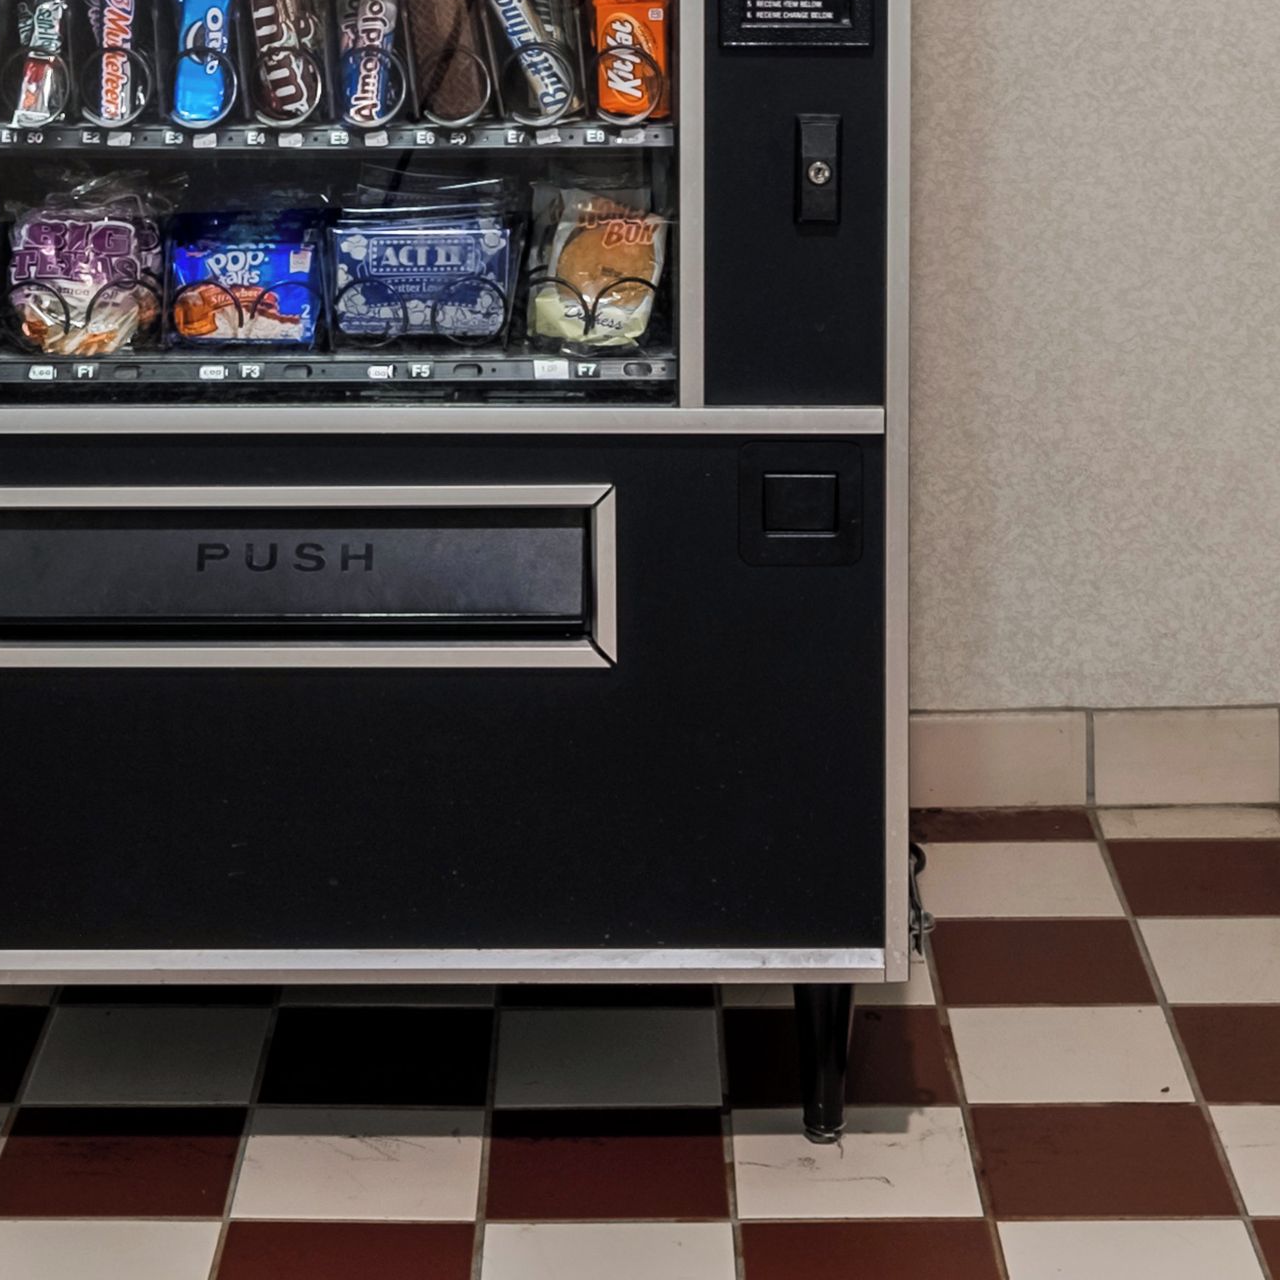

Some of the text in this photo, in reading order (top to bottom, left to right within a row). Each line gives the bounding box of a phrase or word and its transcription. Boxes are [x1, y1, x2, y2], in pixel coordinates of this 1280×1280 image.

[82, 132, 100, 143] E2
[165, 132, 184, 144] E3
[247, 132, 265, 144] E4
[330, 132, 349, 144] E5
[417, 132, 434, 144] E6
[586, 131, 604, 143] E8
[23, 222, 133, 256] BIG
[603, 220, 658, 247] BUN
[381, 246, 429, 266] ACT
[300, 303, 311, 318] 2
[78, 367, 93, 378] F1
[232, 366, 250, 378] F3
[411, 365, 430, 377] F5
[578, 364, 596, 376] F7
[196, 543, 374, 572] PUSH
